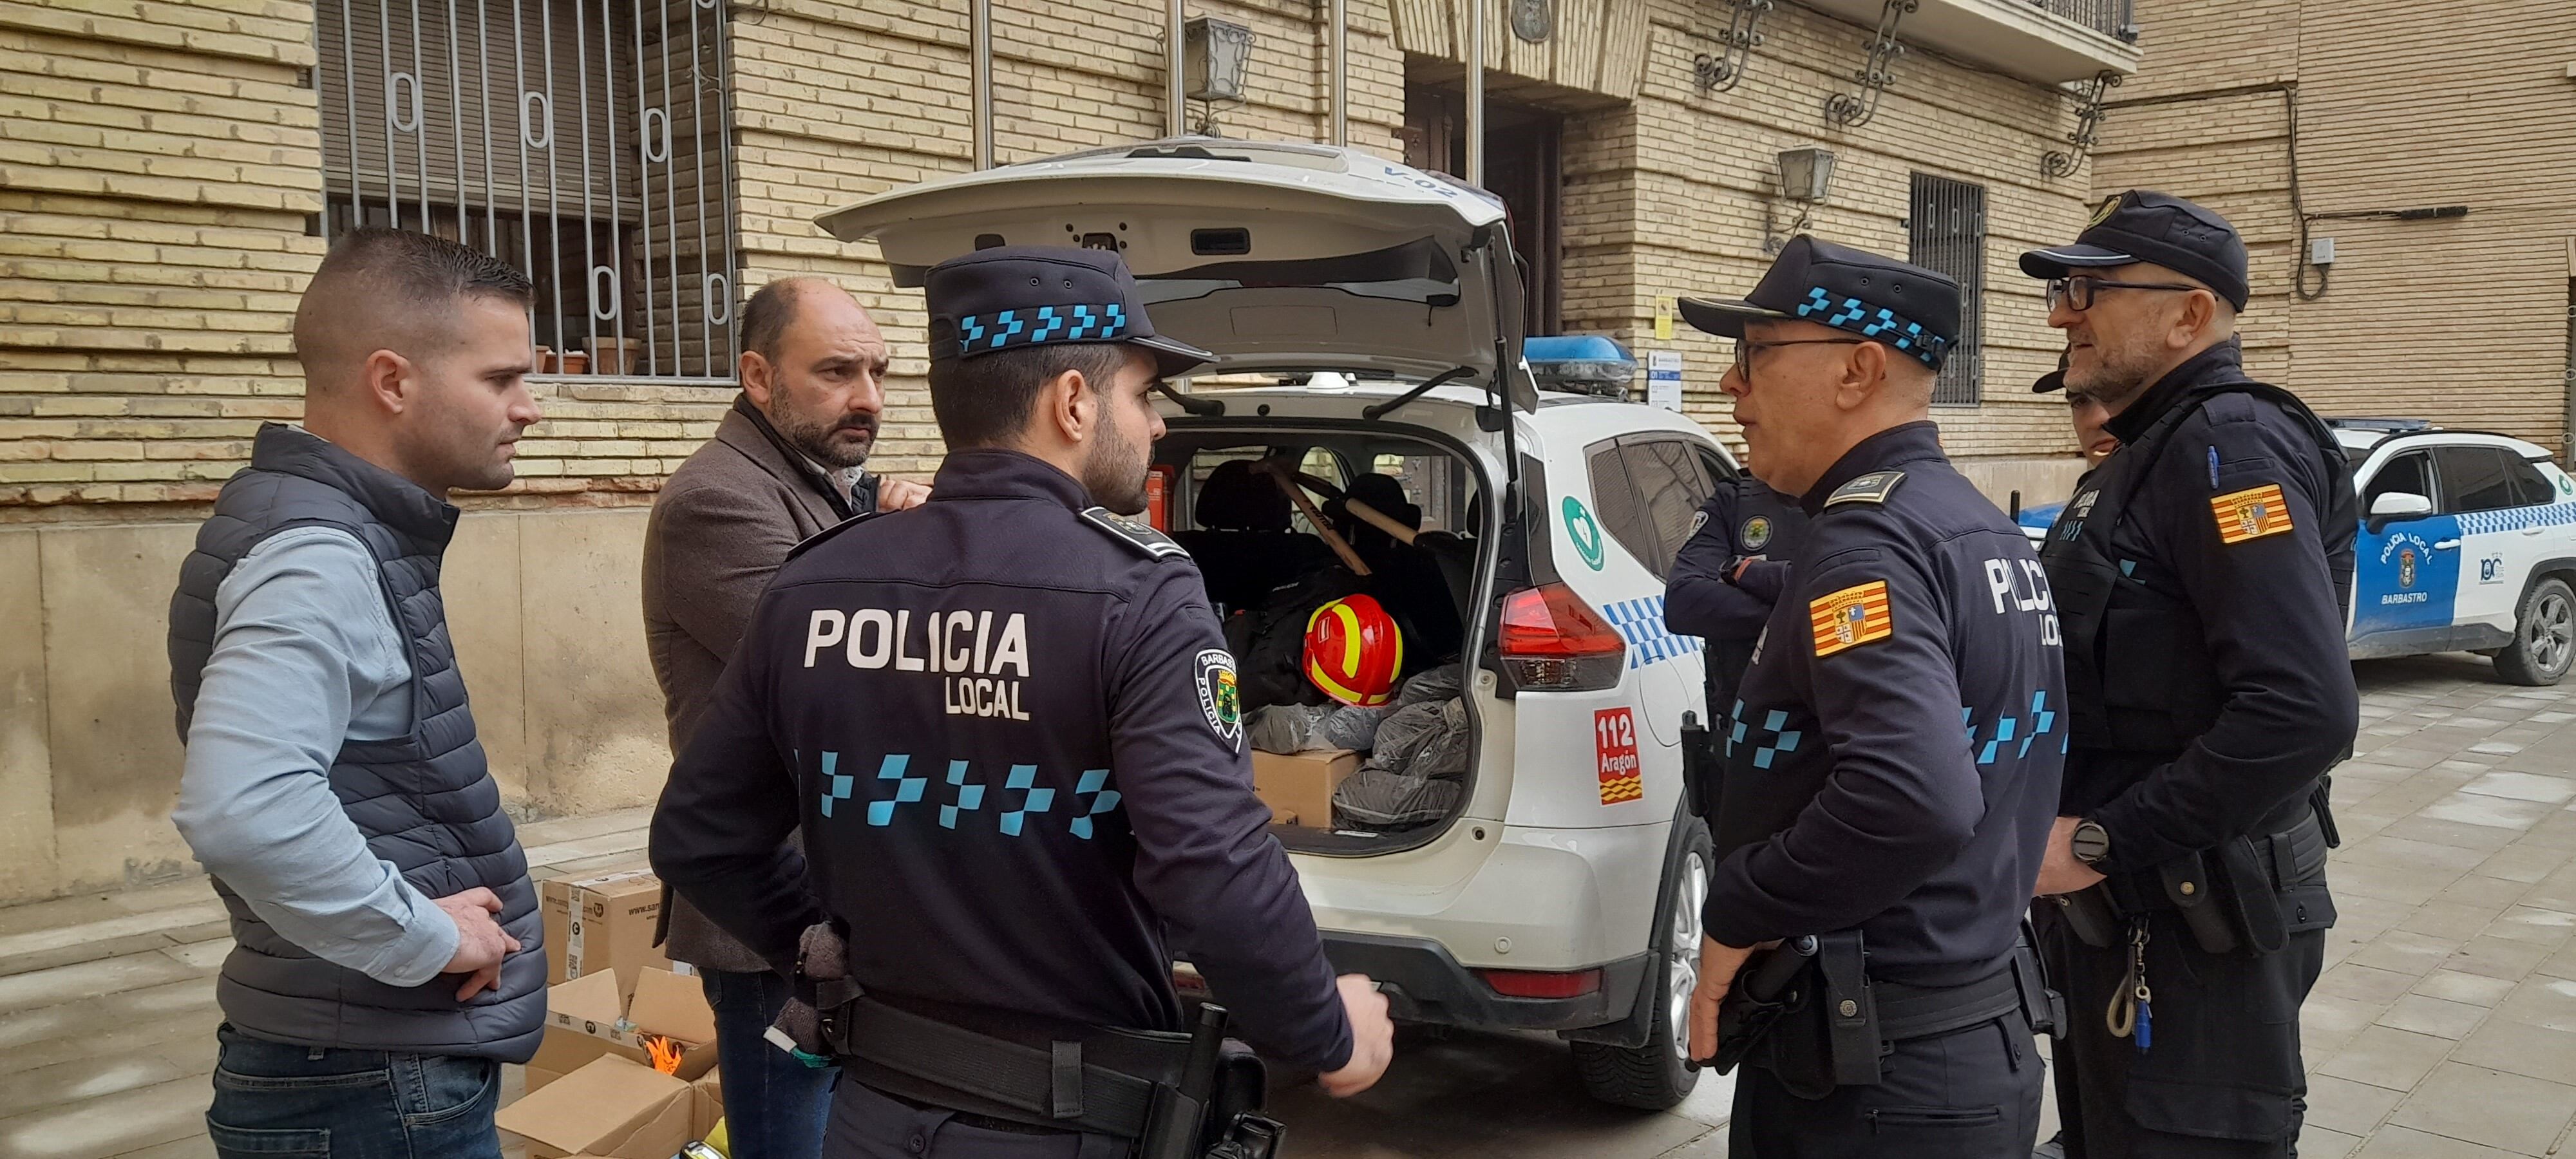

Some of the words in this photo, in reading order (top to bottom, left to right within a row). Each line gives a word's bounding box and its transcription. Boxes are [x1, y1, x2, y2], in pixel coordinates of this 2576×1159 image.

[1385, 166, 1458, 198] V-02
[2381, 532, 2407, 564] POLICIA
[2409, 532, 2432, 565] LOCAL
[2382, 592, 2427, 605] BARBASTRO
[804, 608, 1030, 677] POLICIA
[945, 676, 1030, 721] LOCAL
[1198, 677, 1222, 735] POLICIA
[1598, 713, 1634, 749] 112
[1601, 749, 1637, 776] Aragón
